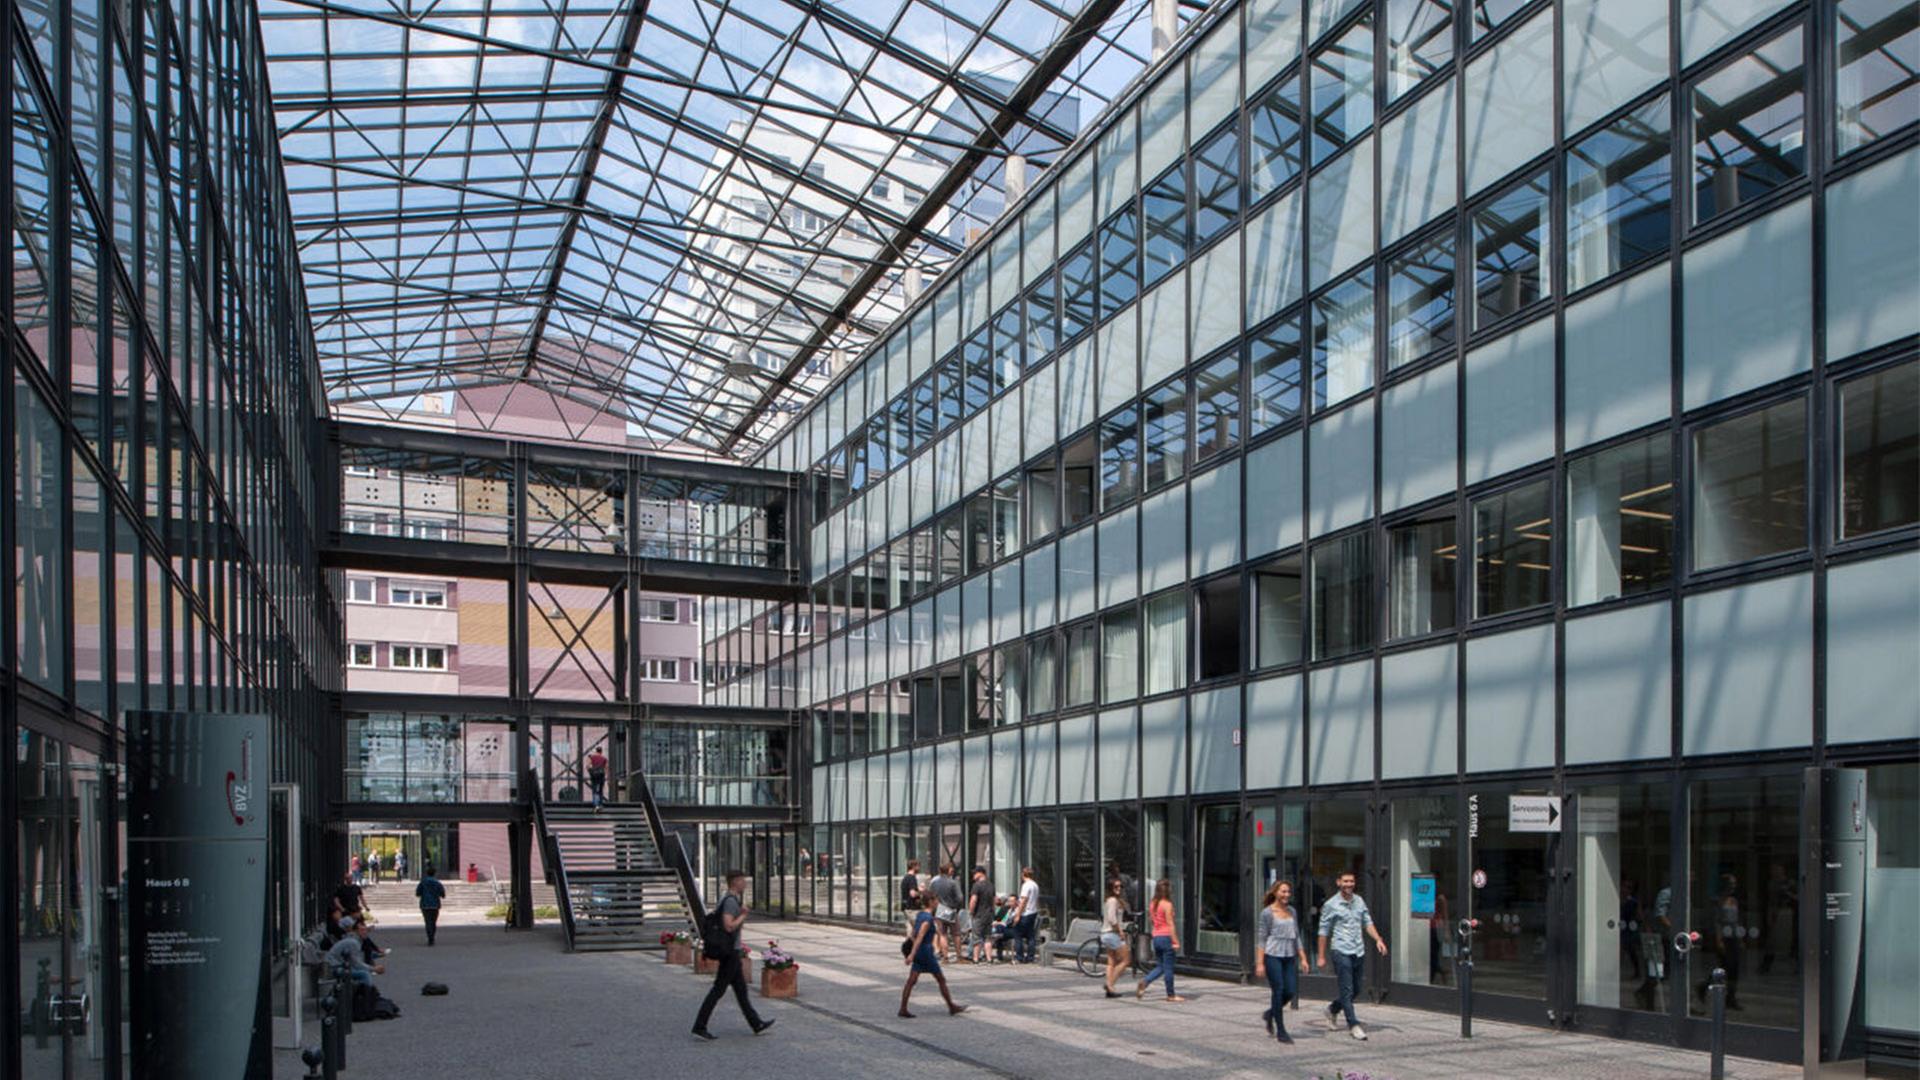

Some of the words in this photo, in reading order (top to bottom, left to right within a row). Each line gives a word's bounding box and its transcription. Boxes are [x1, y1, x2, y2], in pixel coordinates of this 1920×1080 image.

[234, 784, 247, 812] BVZ
[1469, 794, 1478, 803] A
[1469, 803, 1478, 811] 6
[1469, 812, 1478, 838] Haus
[145, 878, 171, 888] Haus
[174, 878, 181, 888] 6
[181, 878, 190, 888] B
